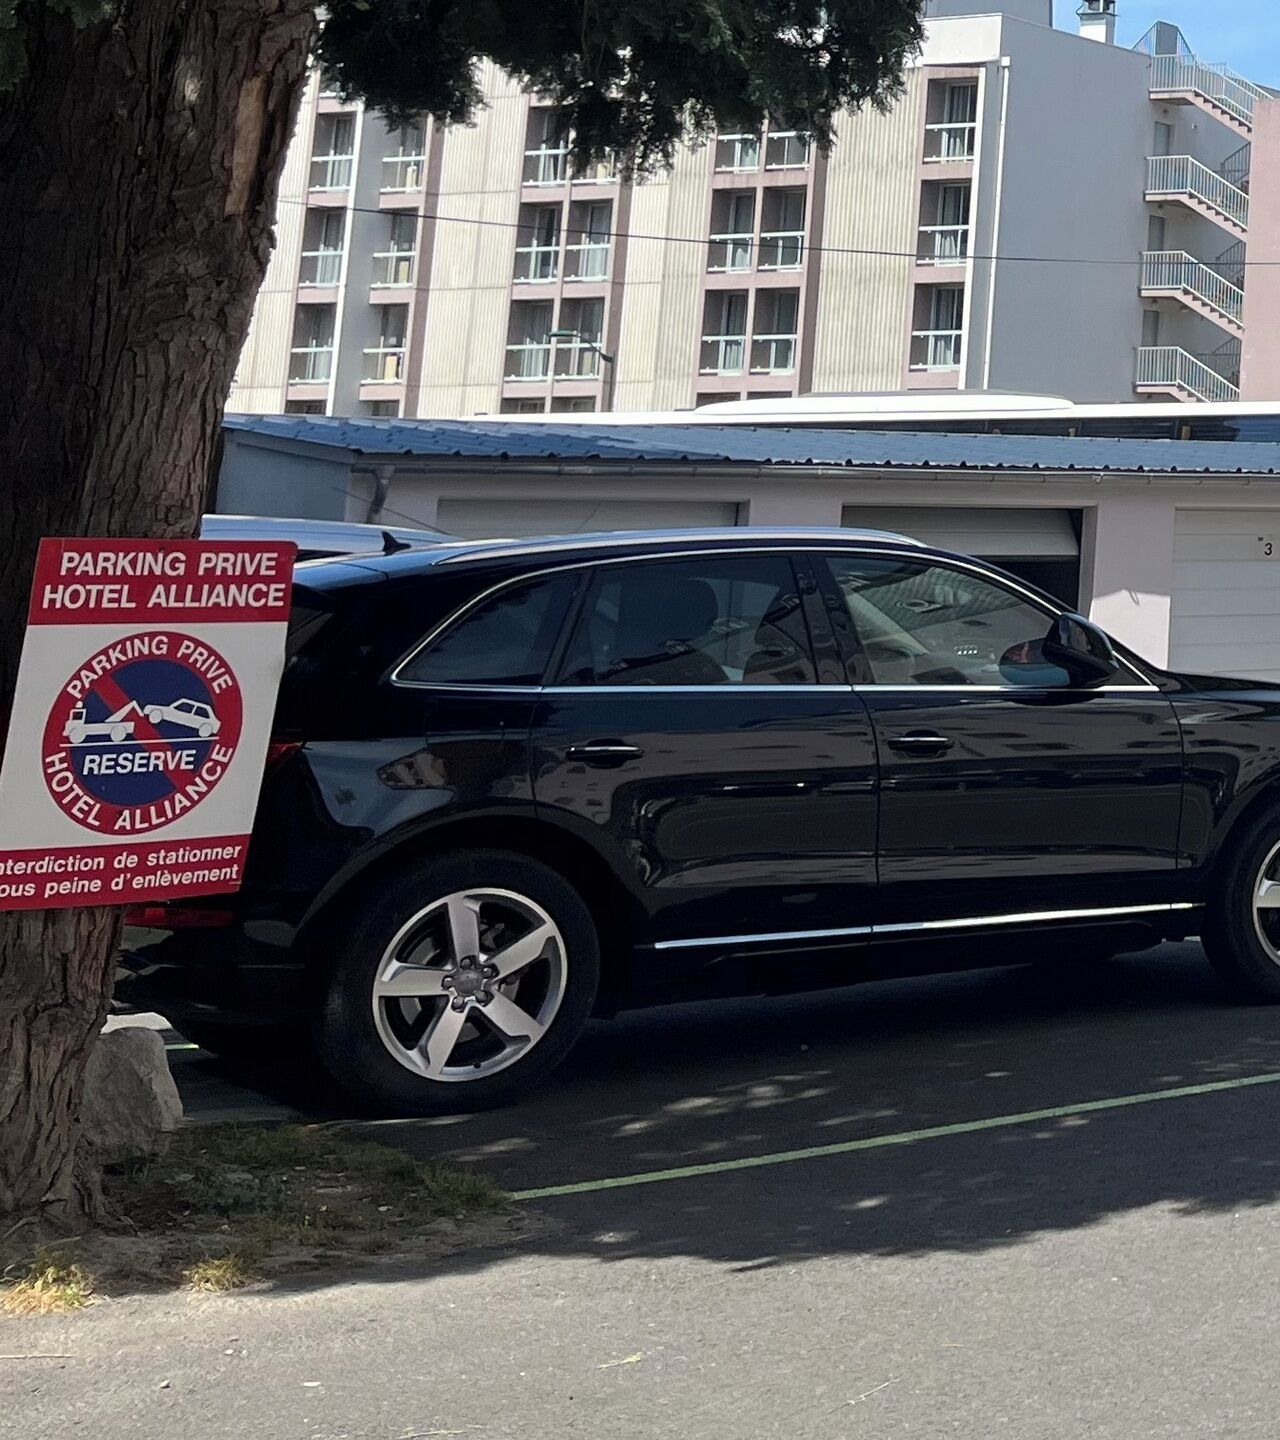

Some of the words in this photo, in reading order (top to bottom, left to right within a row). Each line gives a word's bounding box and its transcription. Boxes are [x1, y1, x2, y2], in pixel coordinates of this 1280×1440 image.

[1264, 542, 1273, 556] 3
[60, 551, 186, 577] PARKING
[198, 552, 278, 576] PRIVE
[42, 584, 136, 610] HOTEL
[147, 583, 286, 609] ALLIANCE
[66, 634, 169, 700] PARKING
[177, 639, 234, 695] PRIVE
[83, 749, 197, 775] RESERVE
[45, 751, 101, 827] HOTEL
[114, 743, 233, 831] ALLIANCE
[113, 851, 137, 869] de
[147, 843, 241, 866] stationner
[44, 876, 101, 899] peine
[110, 864, 239, 891] d'enlèvement
